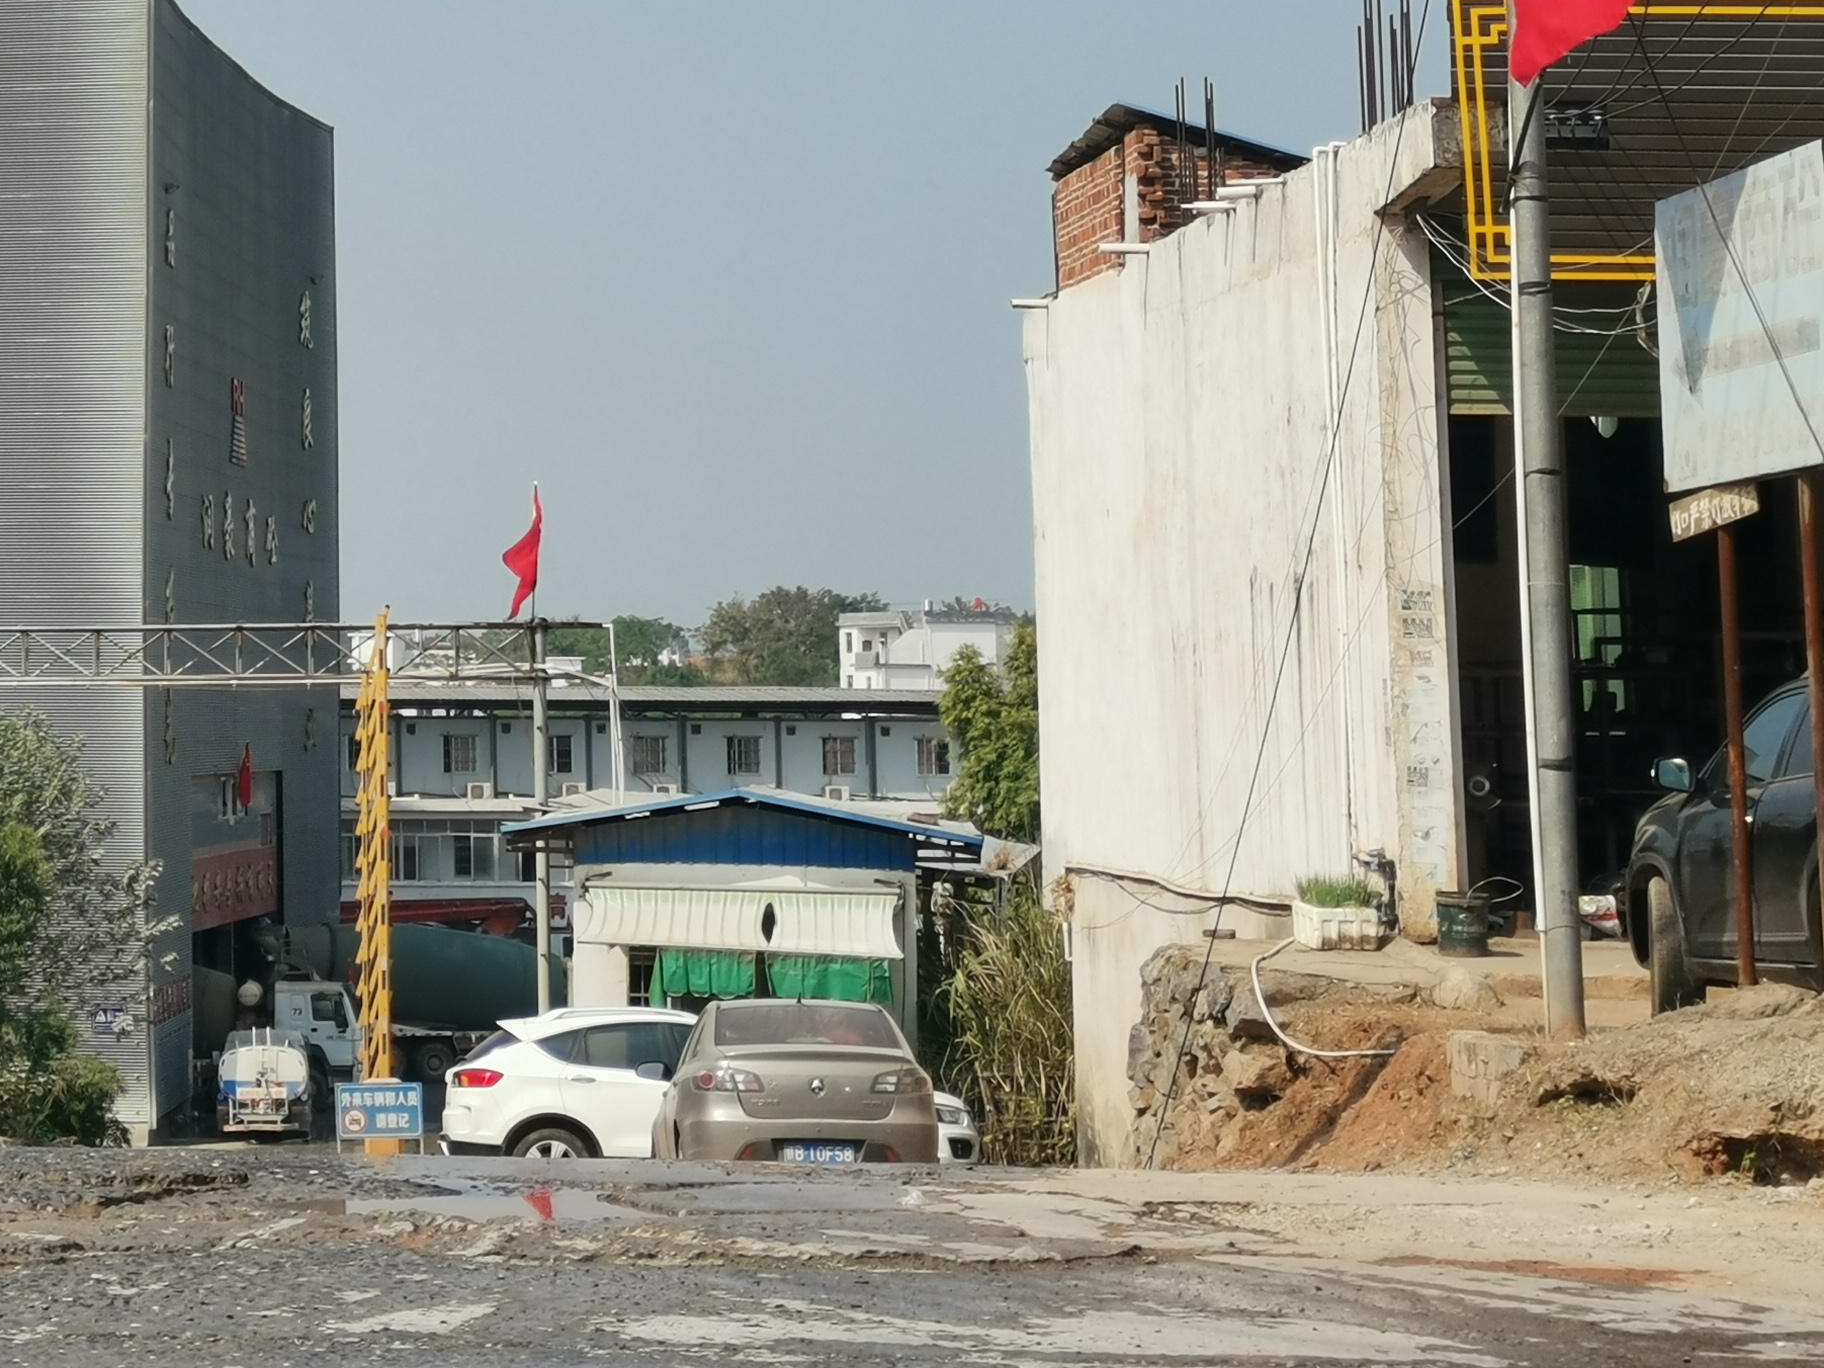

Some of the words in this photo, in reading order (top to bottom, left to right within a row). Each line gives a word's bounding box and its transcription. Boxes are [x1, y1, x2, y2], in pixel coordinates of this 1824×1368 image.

[292, 1007, 303, 1016] 73
[341, 1091, 418, 1107] 外来车辆和人员
[375, 1113, 410, 1129] 请登记
